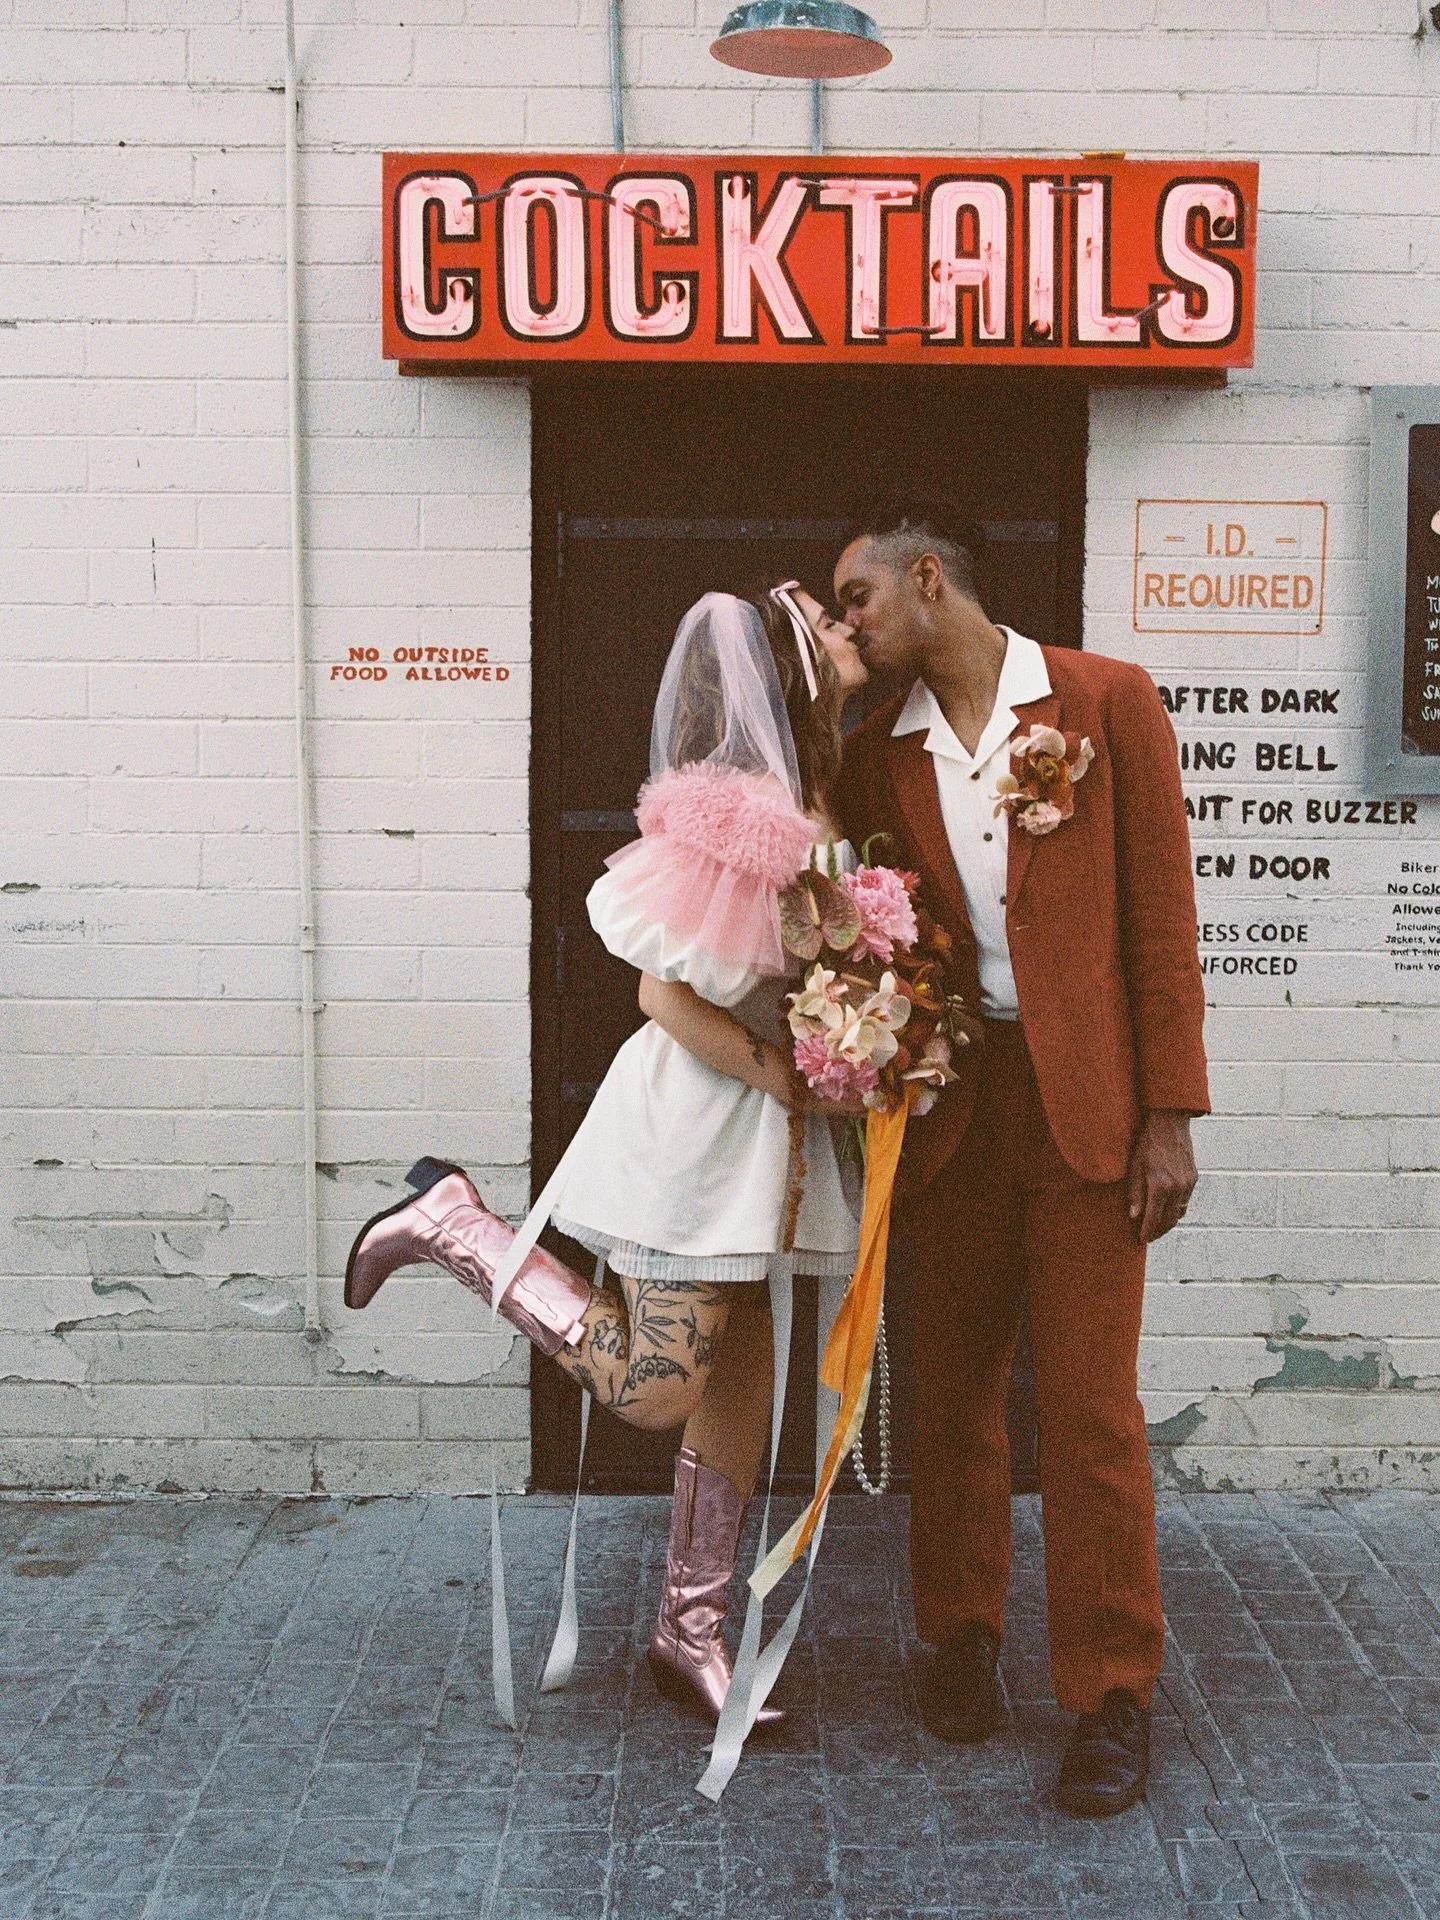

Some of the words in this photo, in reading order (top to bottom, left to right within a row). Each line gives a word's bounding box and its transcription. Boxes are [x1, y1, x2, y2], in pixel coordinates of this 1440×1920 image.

[394, 170, 1246, 346] COCKTAILS
[1206, 523, 1254, 557] I.D.
[1426, 575, 1440, 590] M
[1427, 618, 1440, 631] W
[348, 647, 379, 662] NO
[393, 647, 489, 663] OUTSIDE
[330, 666, 388, 681] FOOD
[405, 667, 510, 681] ALLOWED
[1157, 686, 1249, 714] AFTER
[1261, 688, 1340, 714] DARK
[1181, 741, 1236, 771] ING
[1255, 742, 1338, 771] BELL
[1184, 795, 1233, 821] AIT
[1242, 799, 1293, 825] FOR
[1306, 799, 1418, 824] BUZZER
[1196, 854, 1235, 878] EN
[1250, 855, 1331, 881] DOOR
[1401, 862, 1439, 873] Biker
[1387, 883, 1408, 895] No
[1392, 903, 1440, 914] Allowe
[1247, 924, 1308, 942] CODE
[1394, 962, 1423, 970] Thank
